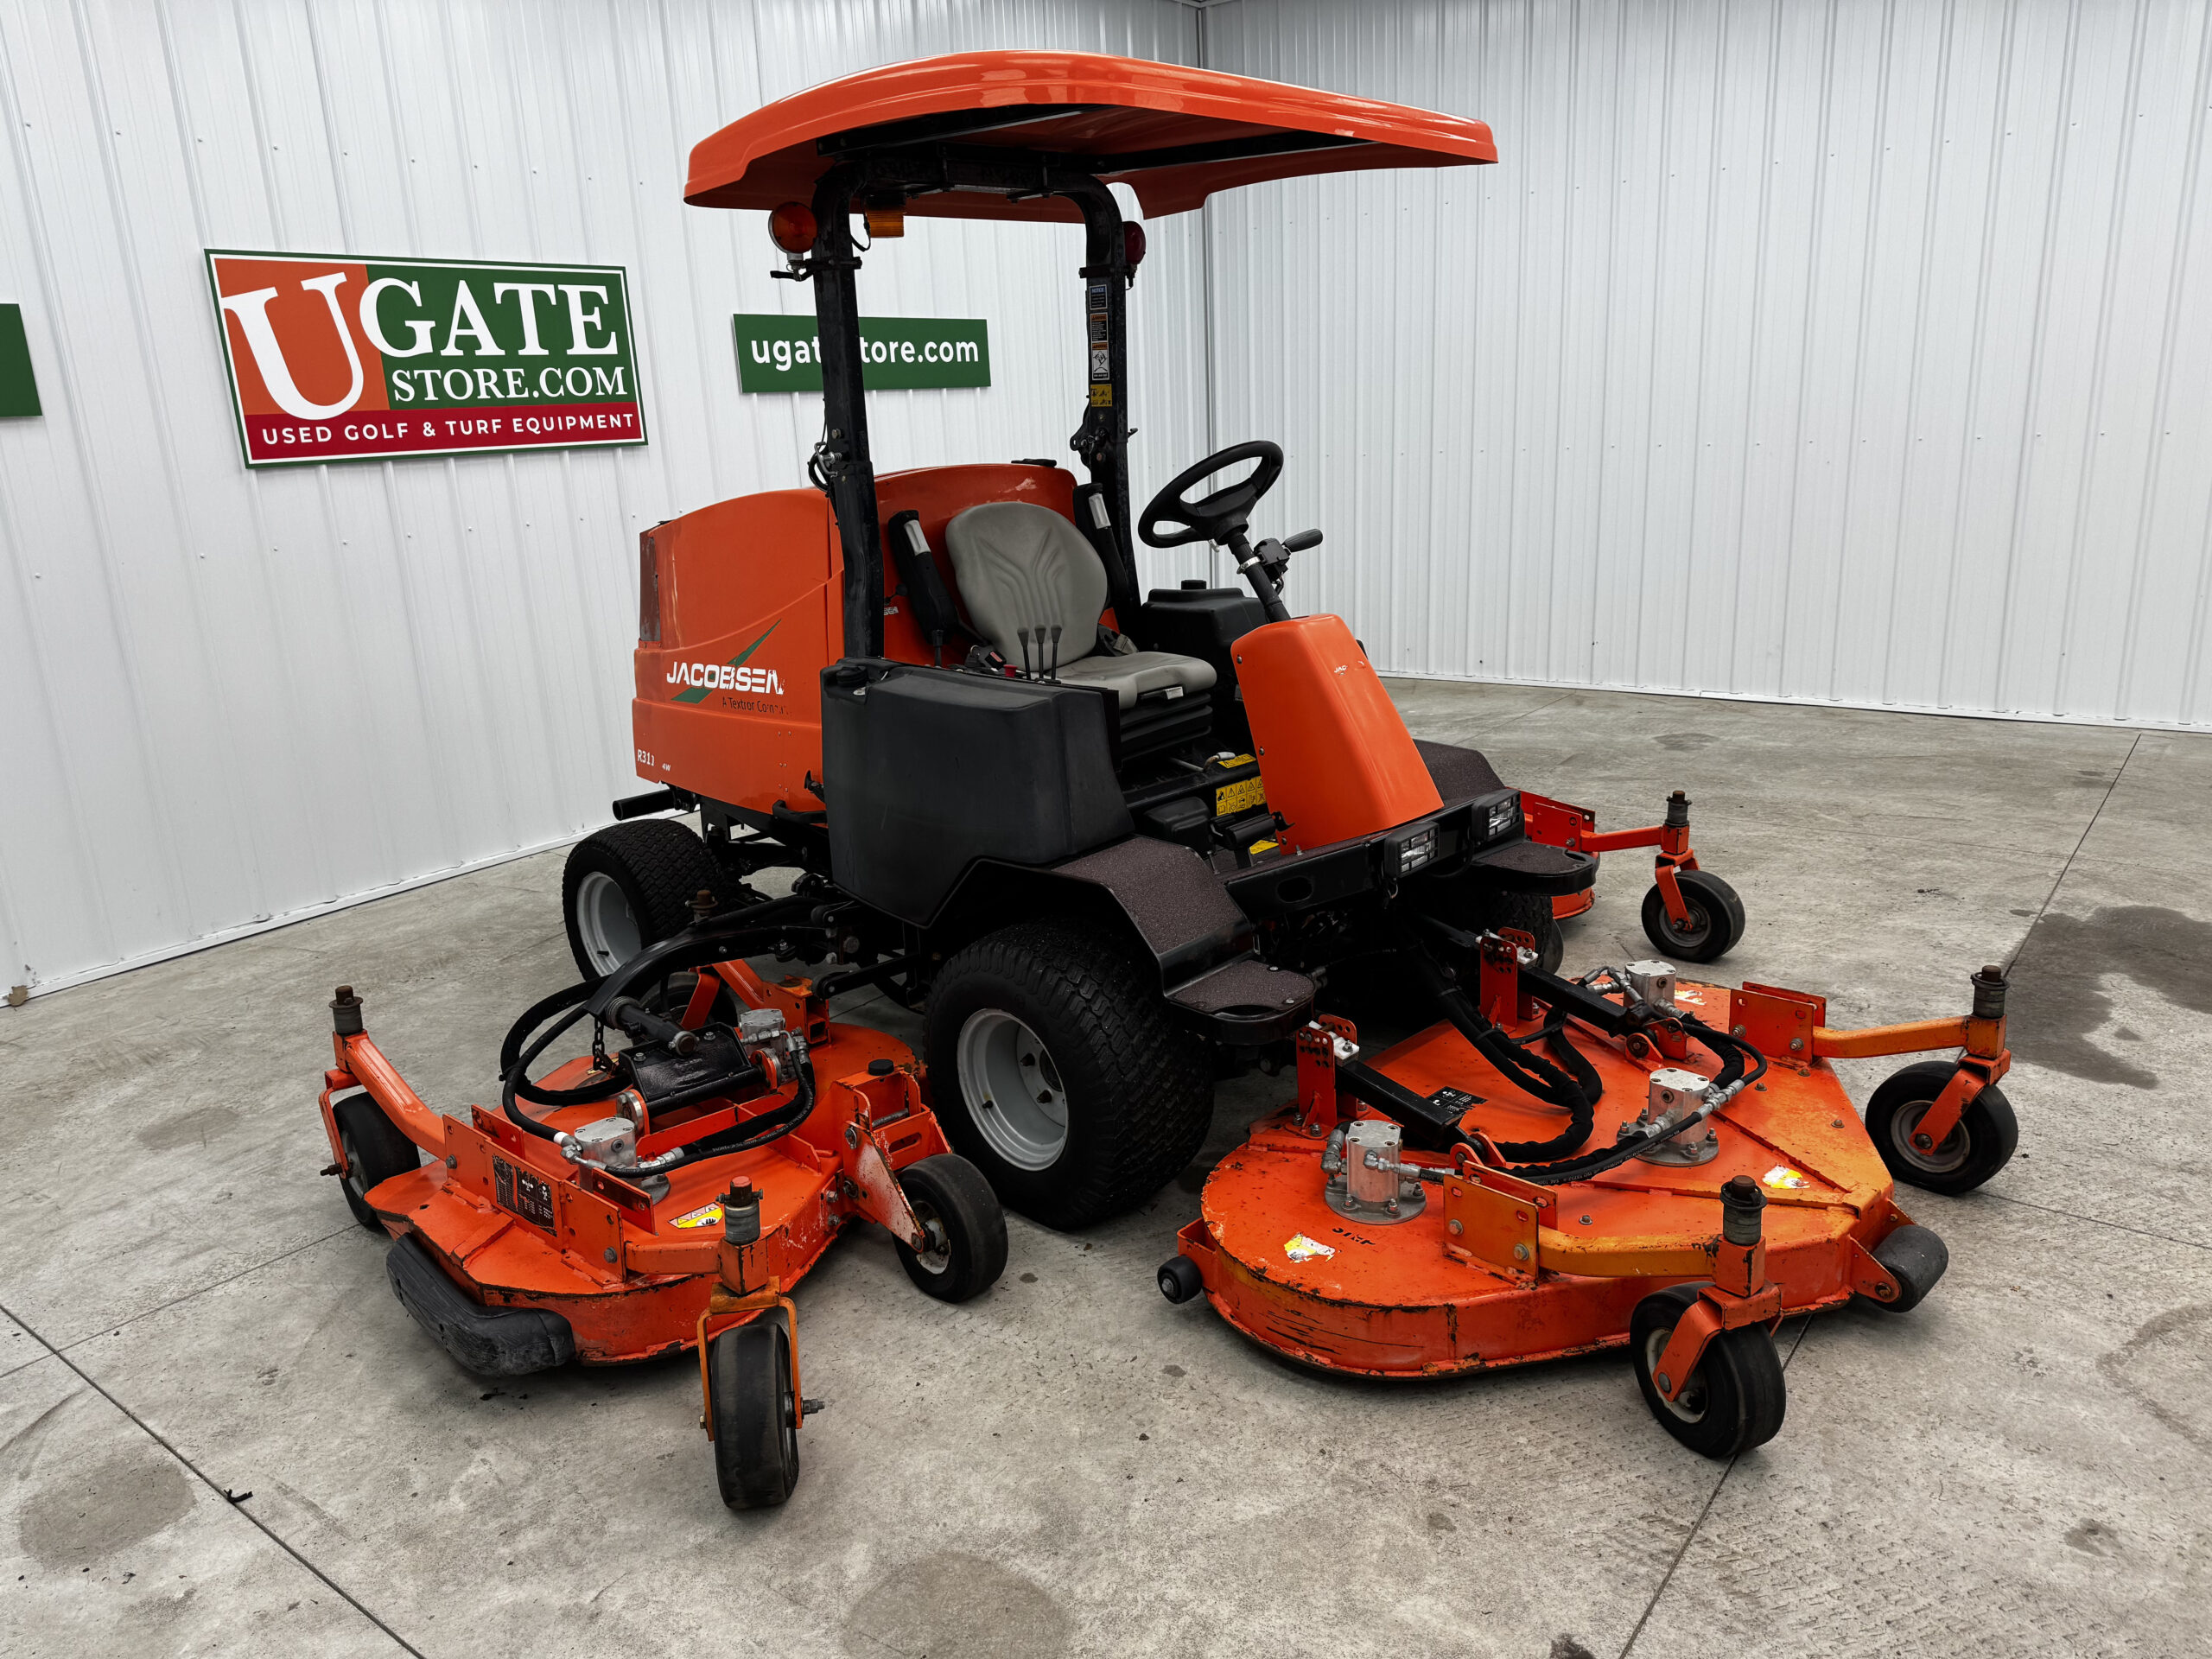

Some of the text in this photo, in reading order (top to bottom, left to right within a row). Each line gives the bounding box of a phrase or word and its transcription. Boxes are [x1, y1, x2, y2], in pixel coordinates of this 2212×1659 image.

[751, 336, 979, 372] ugattore.com
[391, 365, 628, 403] STORE.COM
[262, 413, 634, 446] USED GOLF & TURF EQUIPMENT
